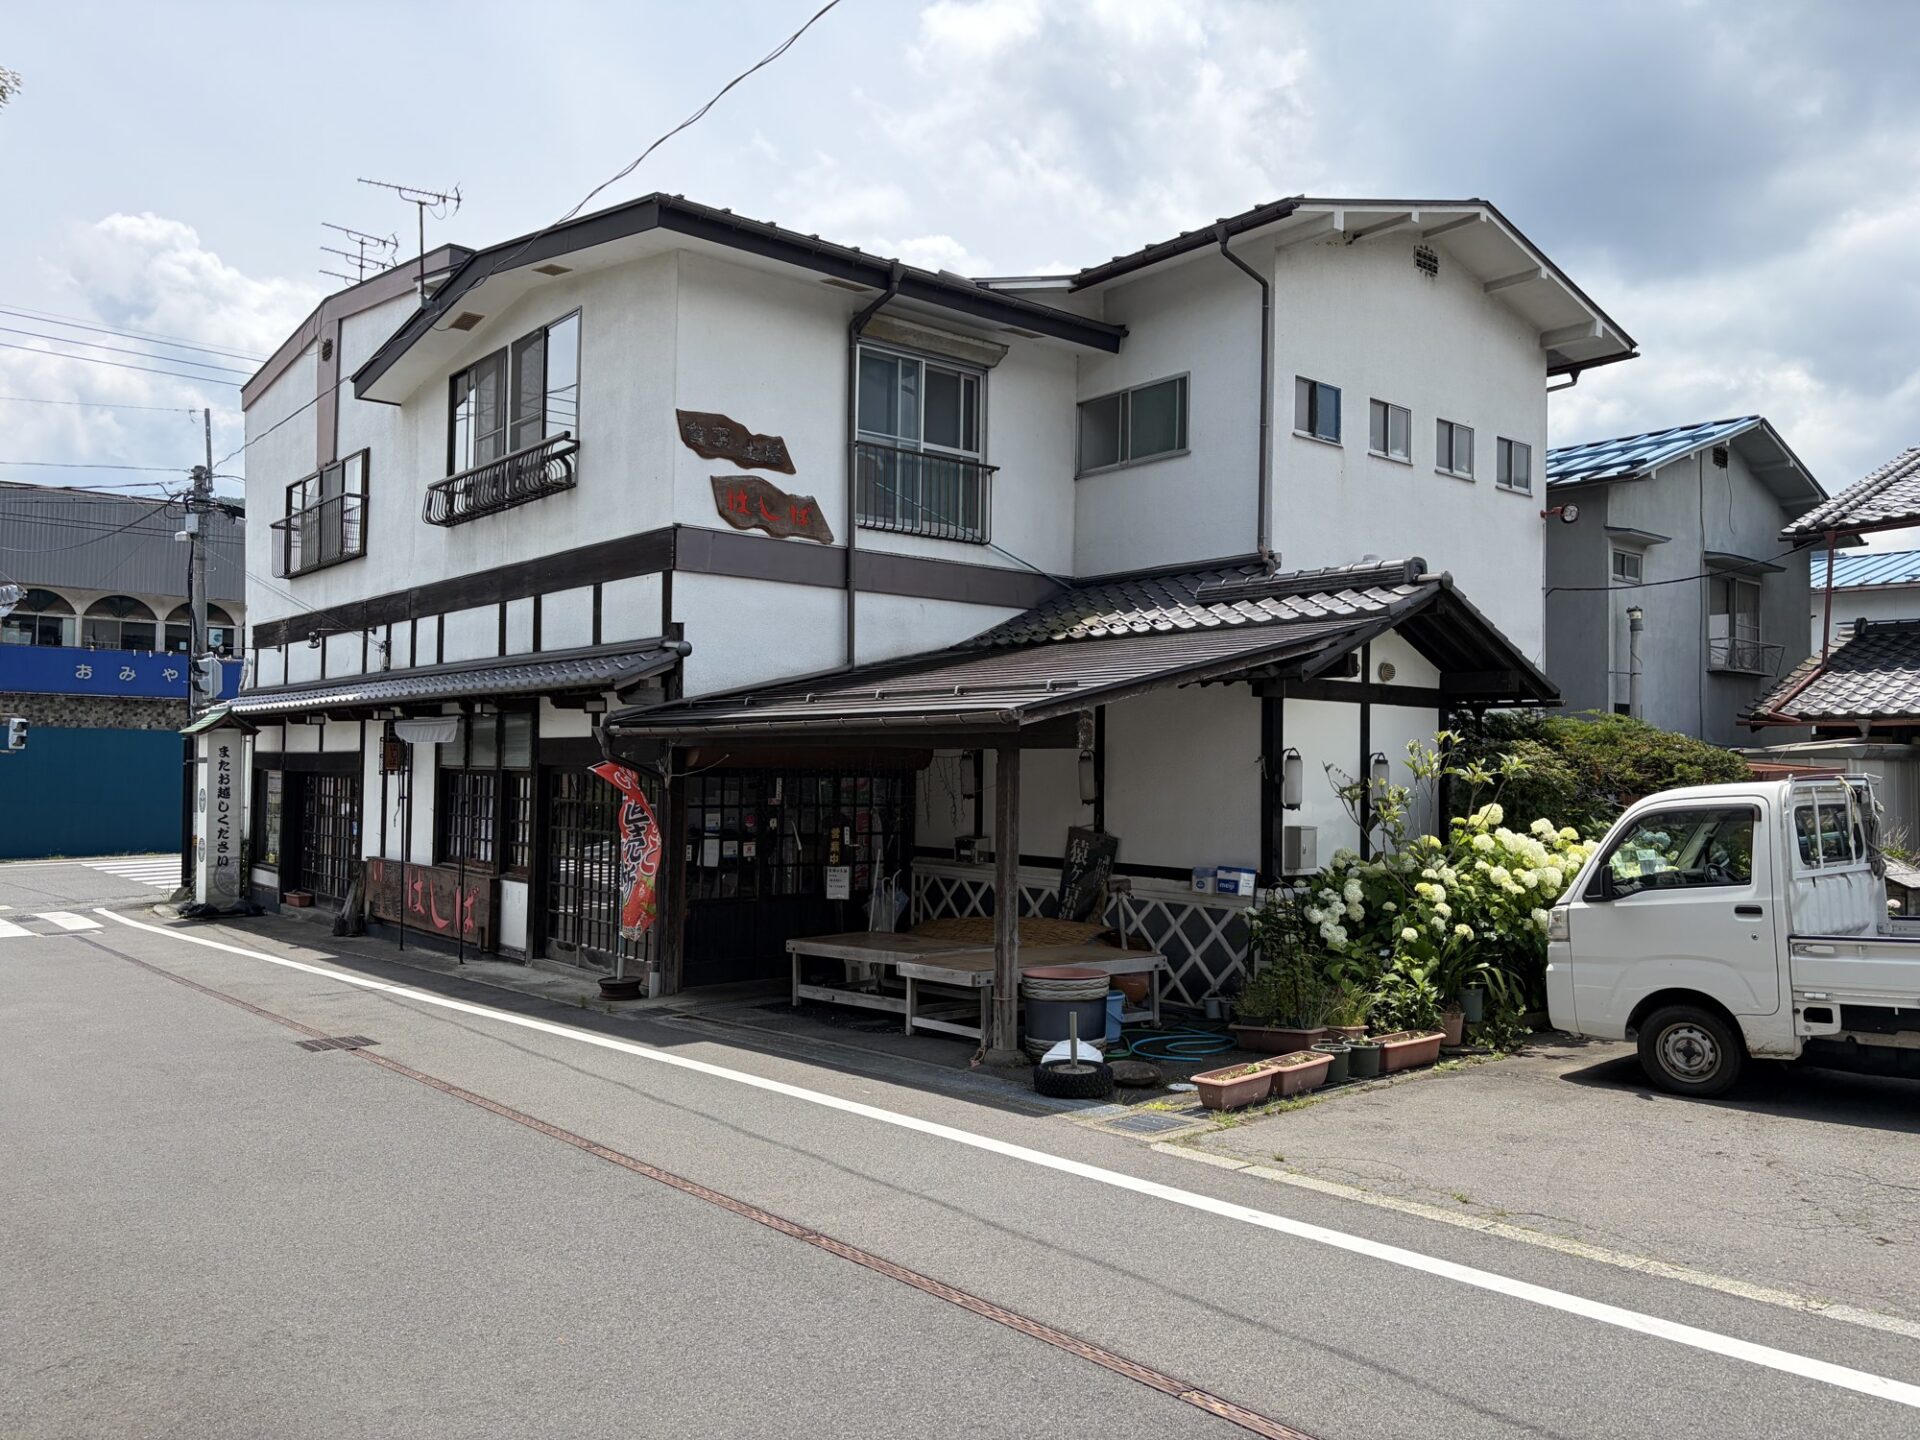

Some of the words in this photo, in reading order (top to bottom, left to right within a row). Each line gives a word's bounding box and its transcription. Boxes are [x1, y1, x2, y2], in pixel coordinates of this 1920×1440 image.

[727, 487, 813, 526] はしば
[75, 664, 179, 682] おみや
[217, 745, 231, 867] またお越しください
[407, 867, 480, 934] はしば
[1219, 882, 1235, 890] meiji
